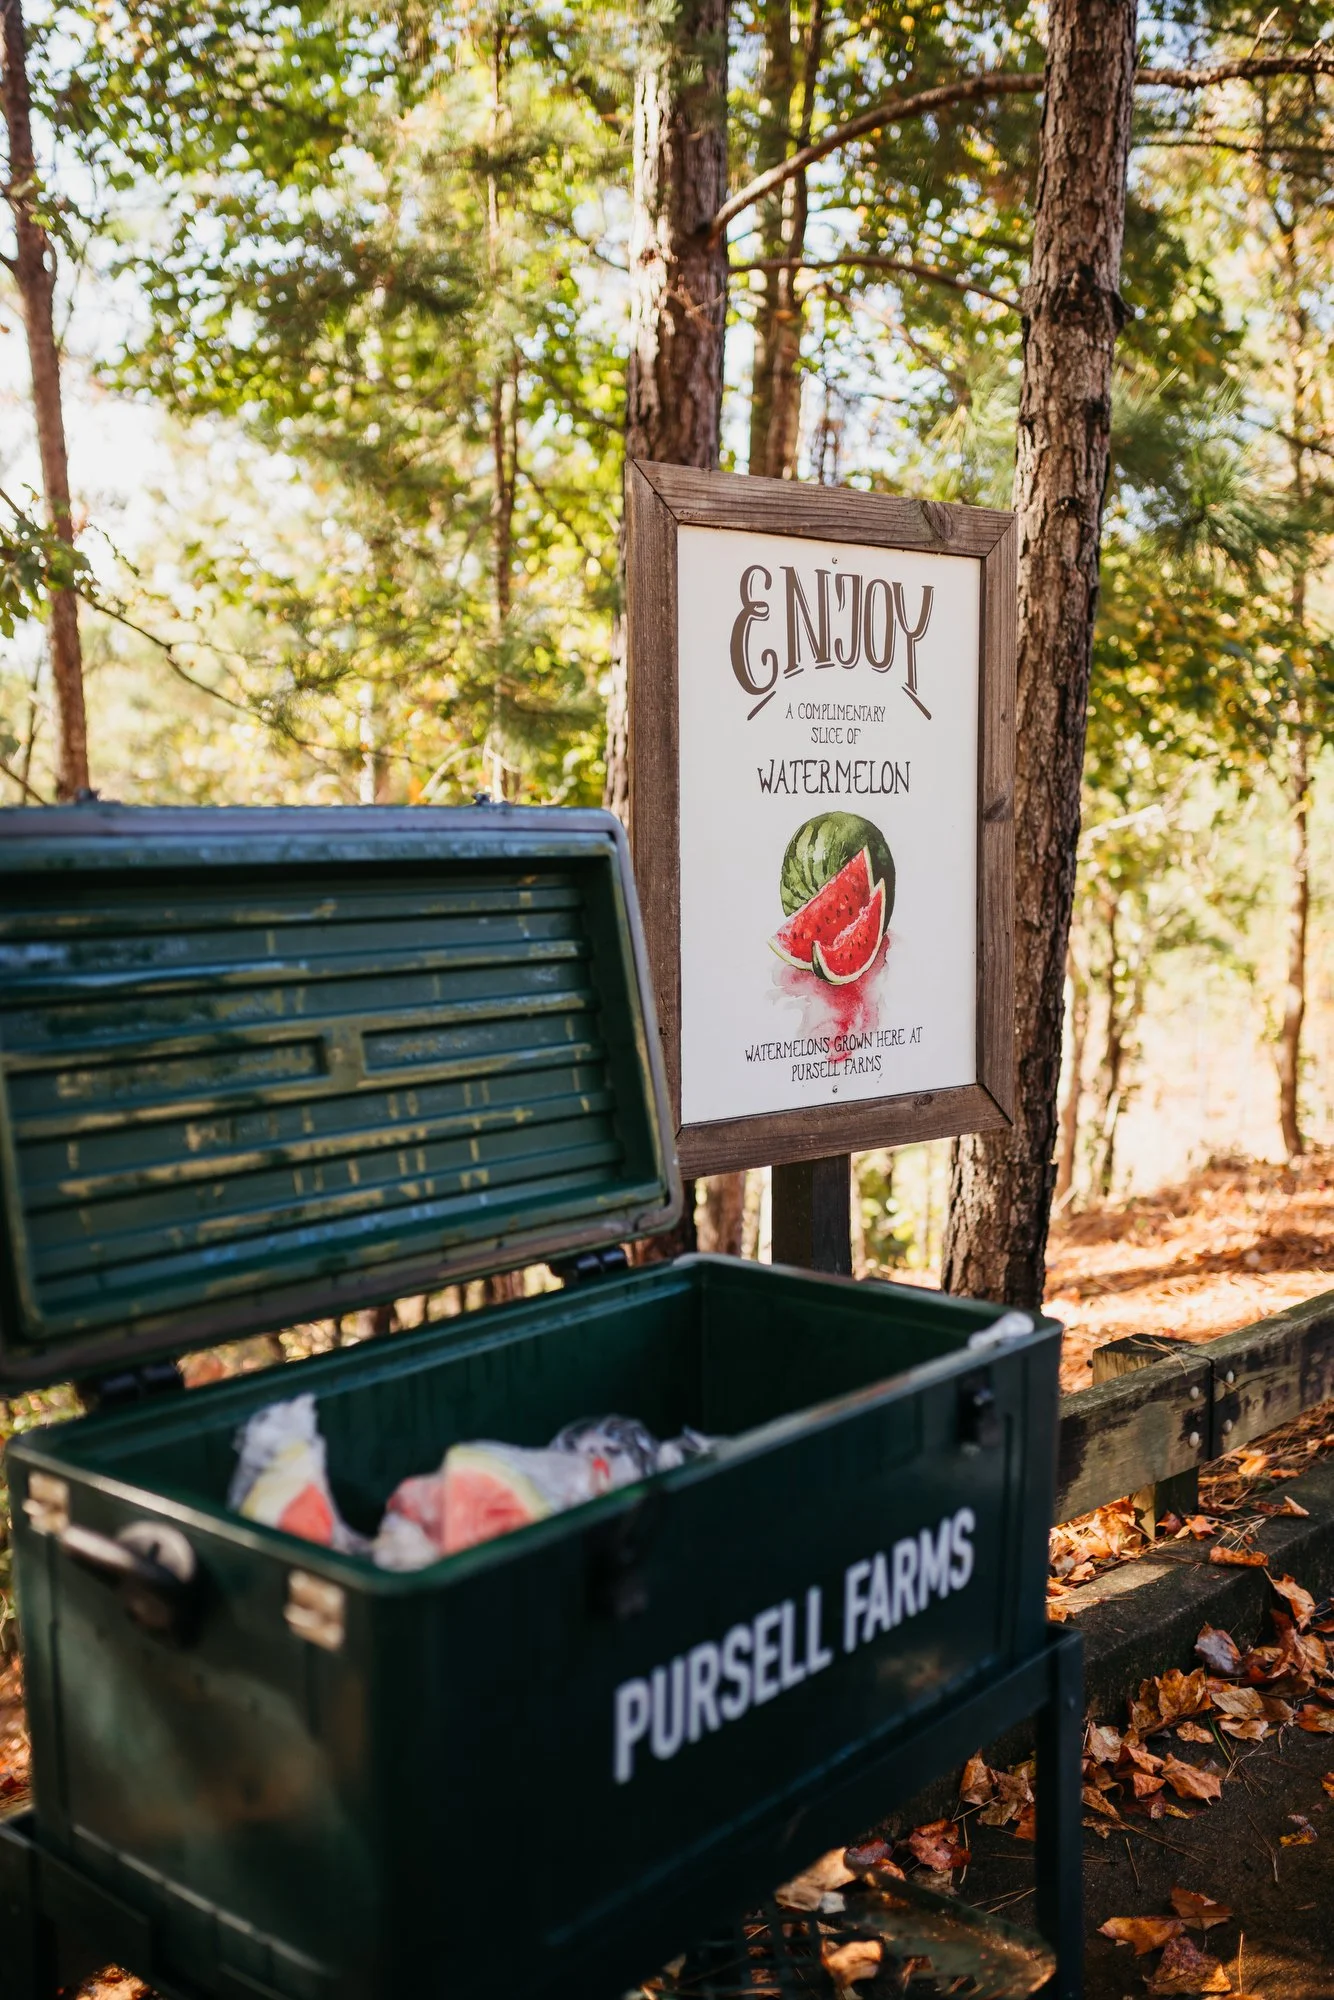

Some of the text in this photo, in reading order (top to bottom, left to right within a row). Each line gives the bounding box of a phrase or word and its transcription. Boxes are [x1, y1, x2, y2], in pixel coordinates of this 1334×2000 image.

[730, 564, 934, 696] ENJOY
[785, 702, 886, 722] A COMPLIMENTARY
[811, 727, 861, 744] SLICE OF
[757, 759, 911, 794] WATERMELON
[745, 1026, 923, 1062] WATERMELONS GROWN HERE AT
[791, 1055, 882, 1082] PURSELL FARMS
[613, 1507, 976, 1784] PURSELL FARMS
